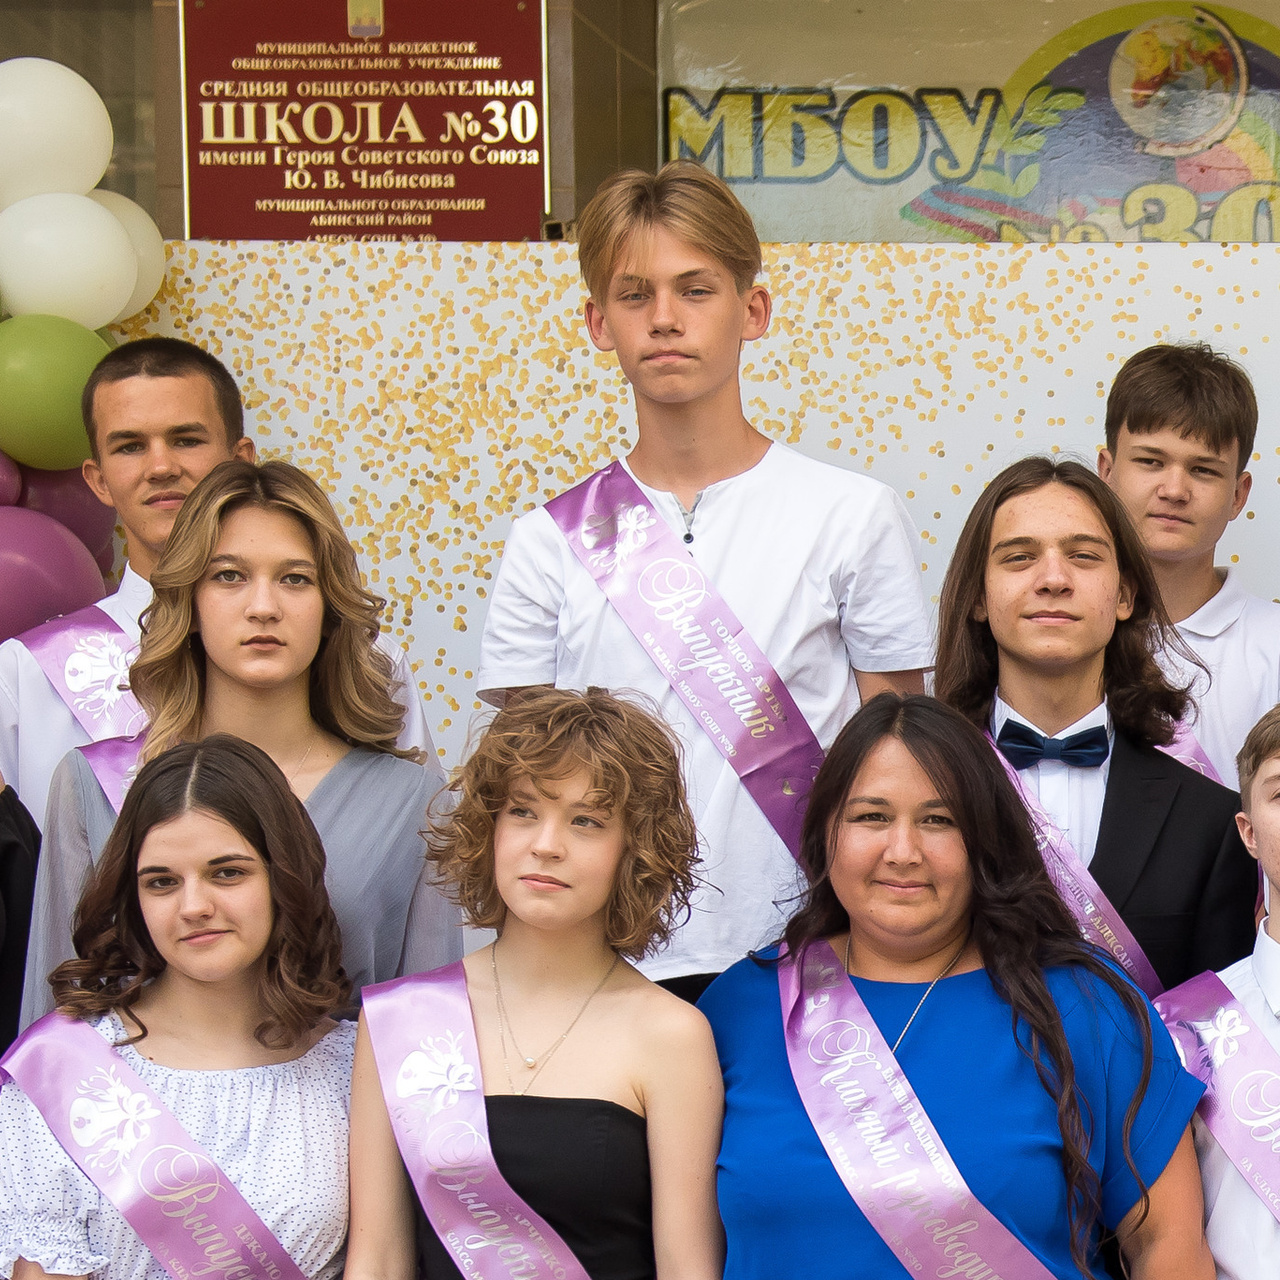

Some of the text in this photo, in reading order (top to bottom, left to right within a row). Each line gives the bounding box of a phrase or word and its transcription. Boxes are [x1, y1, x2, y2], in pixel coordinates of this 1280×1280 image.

[231, 56, 502, 71] ОБЩЕОБРАЗОВАТЕЛЬНОЕ УЧРЕЖДЕНИЕ
[256, 41, 478, 56] МУНИЦИПАЛЬНОЕ БЮДЖЕТНОЕ
[199, 79, 535, 98] СРЕДНЯЯ ОБЩЕОБРАЗОВАТЕЛЬНАЯ
[199, 100, 539, 144] ШКОЛА №30
[662, 87, 1004, 185] МБОУ
[199, 144, 540, 170] имени Героя Советского Союза
[284, 169, 456, 190] Ю. В. Чибисова
[255, 198, 487, 213] МУНИЦИПАЛЬНОГО ОБРАЗОВАНИЯ
[309, 212, 433, 226] АБИНСКИЙ РАЙОН
[637, 557, 775, 739] Выпускник
[709, 617, 755, 673] ГОРЛОВ
[677, 680, 703, 709] МБОУ
[699, 709, 722, 735] СОШ
[808, 1019, 915, 1169] Классный
[880, 1066, 971, 1211] ЕВГЕНИЯ ВЛАДИМИРОВНА
[1240, 1156, 1254, 1173] 9А
[232, 1223, 283, 1280] ДЕКАЛО
